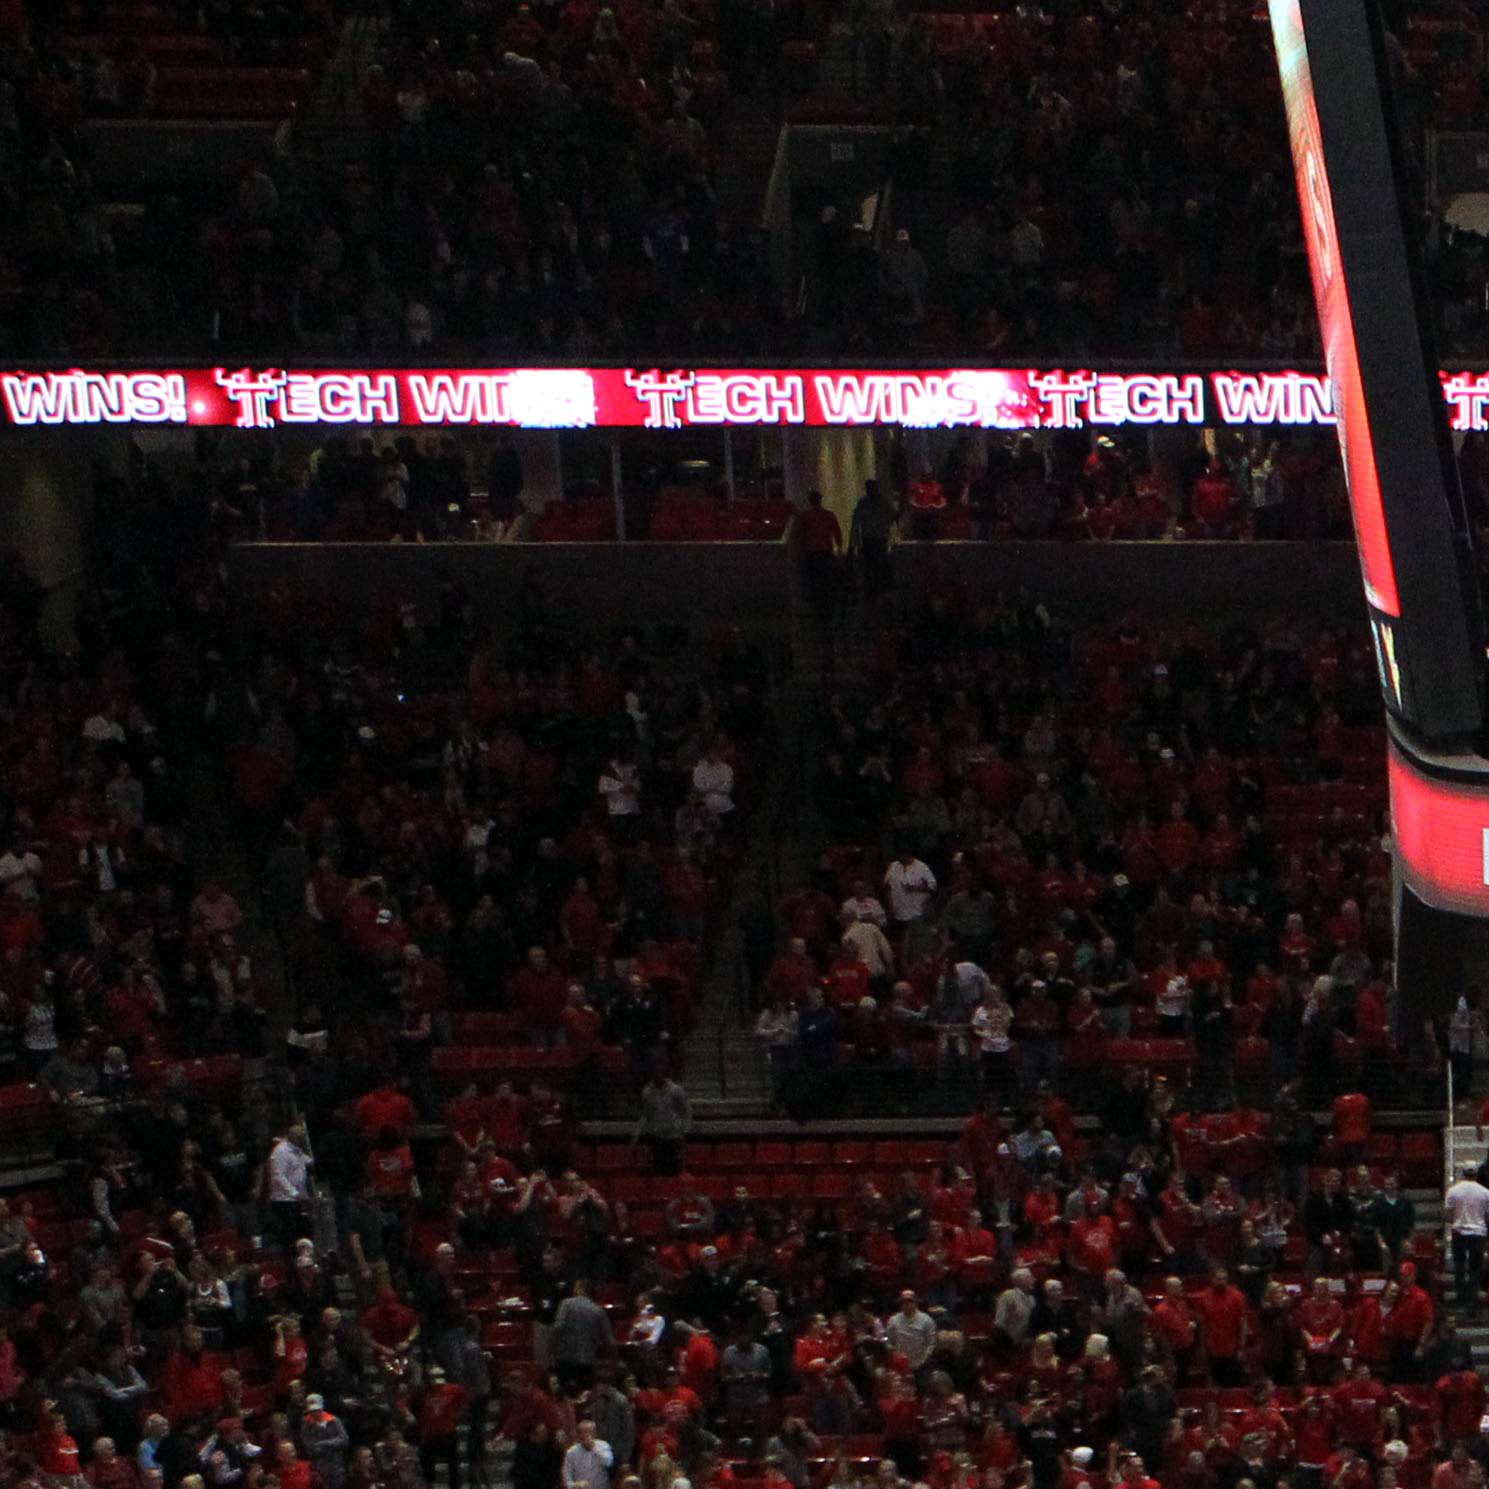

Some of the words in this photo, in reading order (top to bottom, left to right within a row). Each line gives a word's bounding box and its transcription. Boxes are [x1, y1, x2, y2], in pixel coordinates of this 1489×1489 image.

[215, 368, 399, 427] TECH
[625, 368, 804, 427] TECH
[1029, 369, 1203, 428] TECH
